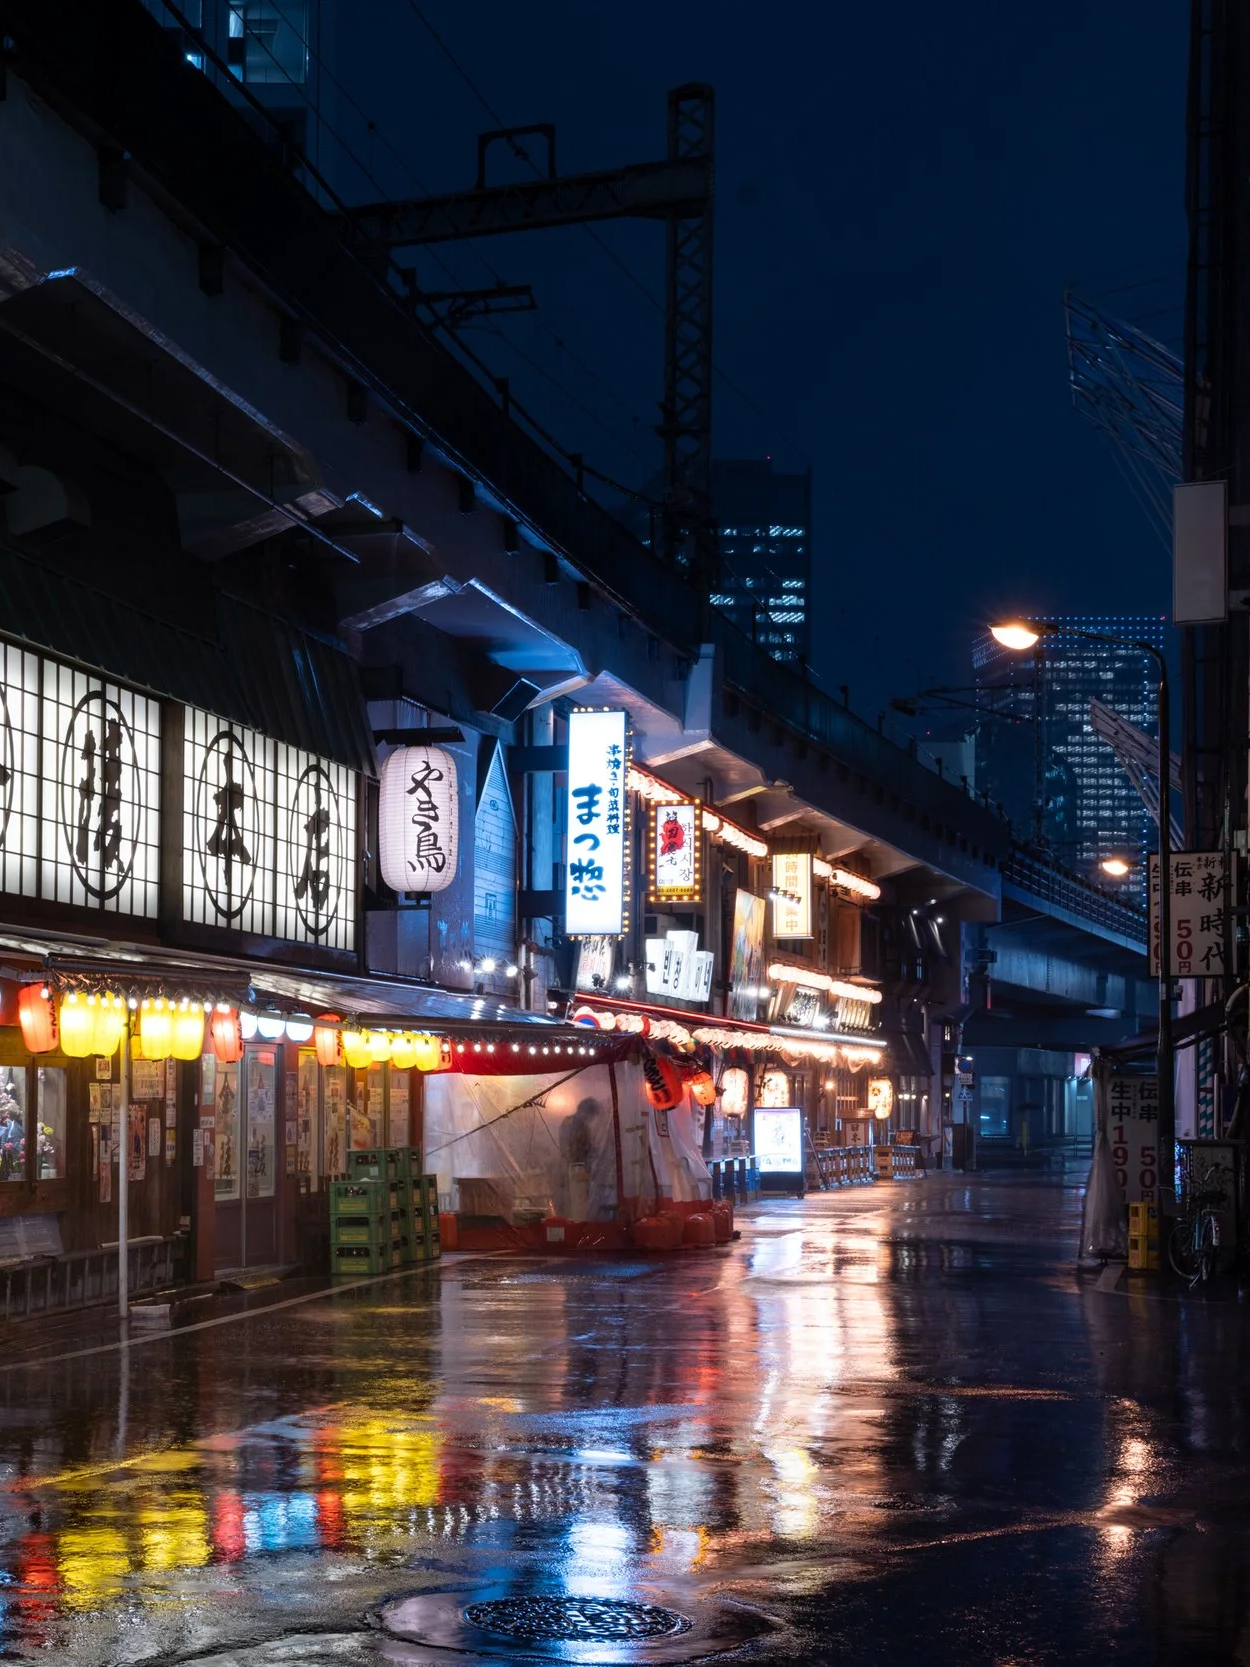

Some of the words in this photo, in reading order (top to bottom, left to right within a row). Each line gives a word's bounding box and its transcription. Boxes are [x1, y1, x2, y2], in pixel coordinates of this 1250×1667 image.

[405, 760, 447, 874] やき鳥
[570, 782, 607, 902] まつ惣
[1174, 861, 1193, 897] 伝串
[1176, 919, 1193, 974] 50円
[1110, 1080, 1133, 1123] 生中
[1138, 1080, 1159, 1123] 伝串
[1112, 1125, 1129, 1201] 190
